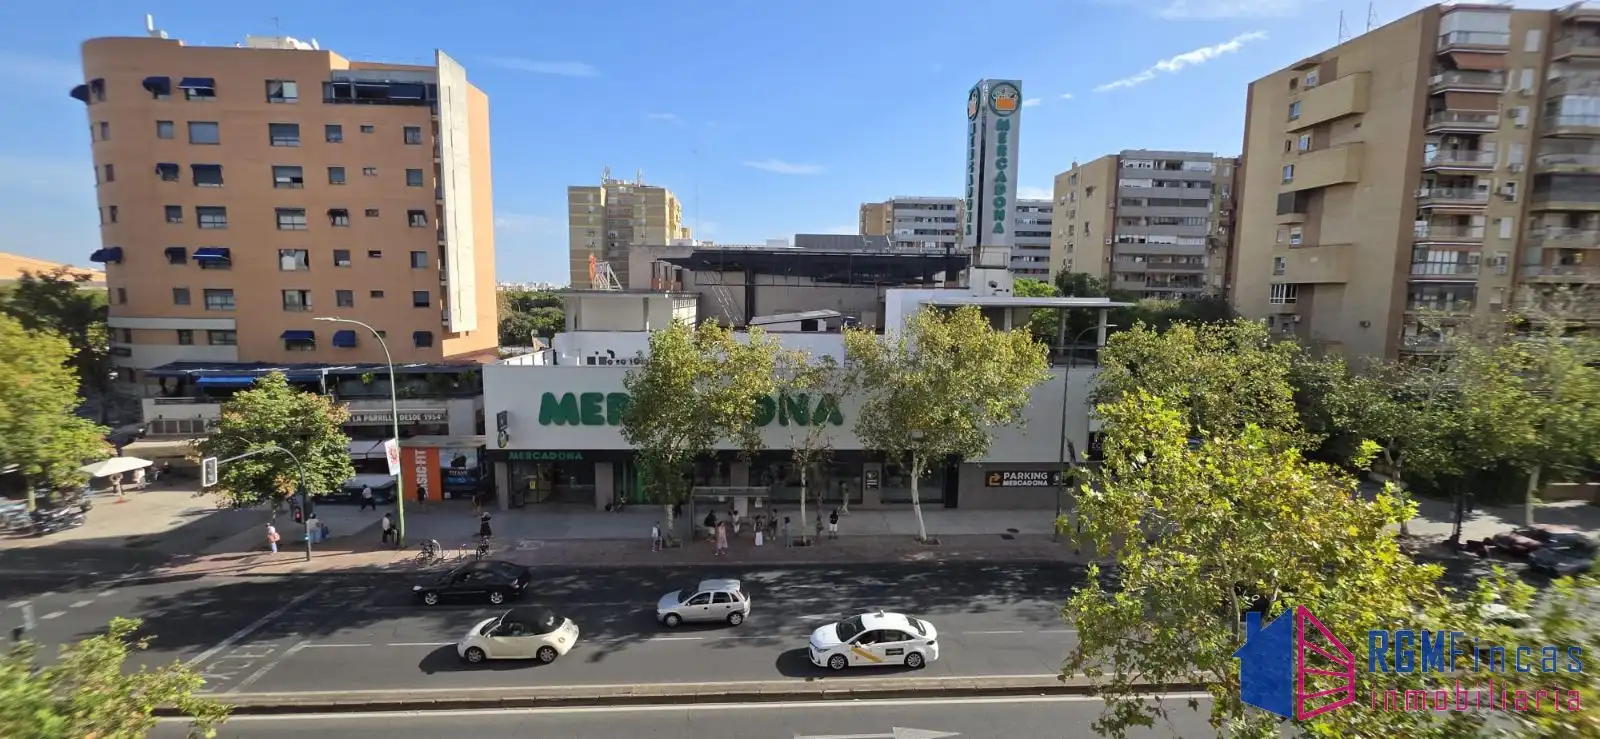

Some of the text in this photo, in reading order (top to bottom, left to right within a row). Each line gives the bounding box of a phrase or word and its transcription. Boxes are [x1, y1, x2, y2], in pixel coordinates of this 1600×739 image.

[991, 118, 1010, 234] MERCADONA
[364, 414, 393, 422] PARRILL
[509, 452, 583, 460] MERCADONA
[1004, 472, 1048, 480] PARKING
